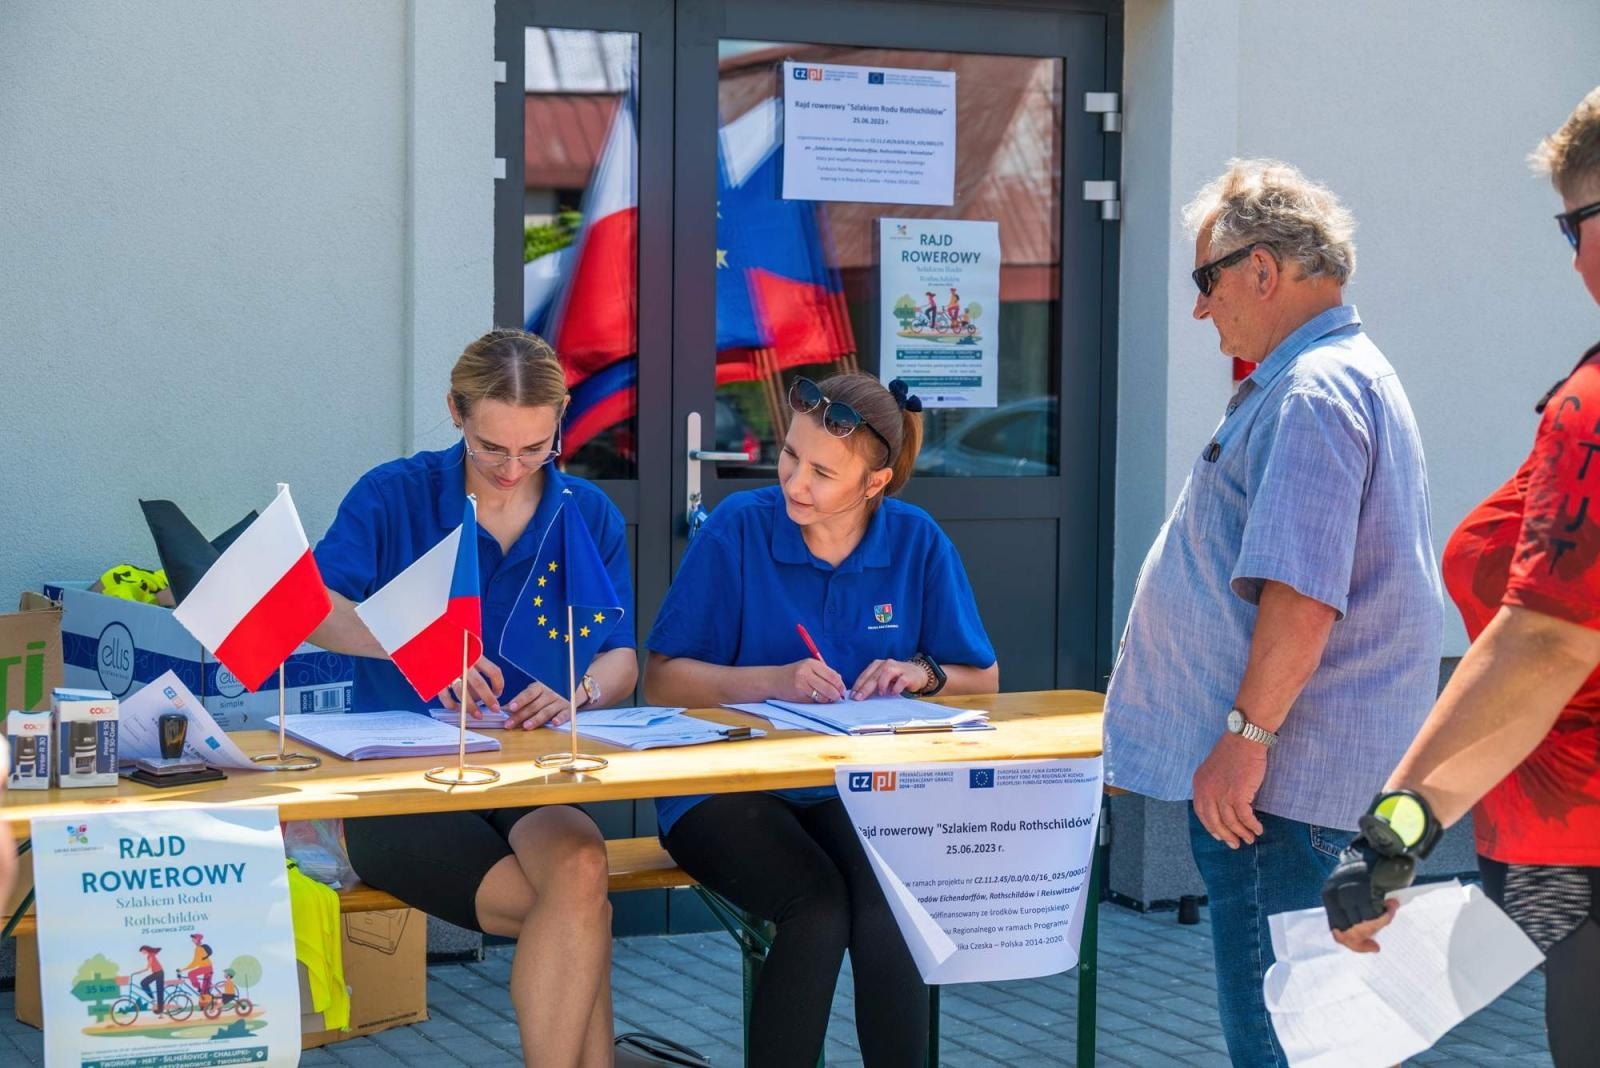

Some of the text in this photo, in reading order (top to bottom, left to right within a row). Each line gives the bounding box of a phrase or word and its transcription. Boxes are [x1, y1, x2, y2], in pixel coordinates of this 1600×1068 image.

[795, 101, 810, 109] Rajd
[812, 103, 845, 111] rowerowy
[920, 234, 953, 246] RAJD
[902, 250, 981, 263] ROWEROWY
[102, 637, 130, 671] ellis
[859, 813, 1095, 839] ajd rowerowy "Szlakiem Rodu Rothschildów"
[119, 835, 186, 860] RAJD
[946, 843, 1005, 855] 25.06.2023 r.
[82, 862, 247, 894] ROWEROWY
[937, 879, 965, 889] projektu
[116, 892, 212, 909] Szlakiem Rodu
[989, 891, 1035, 899] Rothschildów
[989, 907, 1018, 916] środków
[1020, 903, 1070, 915] Europejskiego
[952, 925, 996, 936] Regionalnego
[1005, 924, 1032, 932] ramach
[1034, 919, 1069, 930] Programu
[970, 941, 993, 950] Czeska
[1000, 939, 1023, 948] Polska
